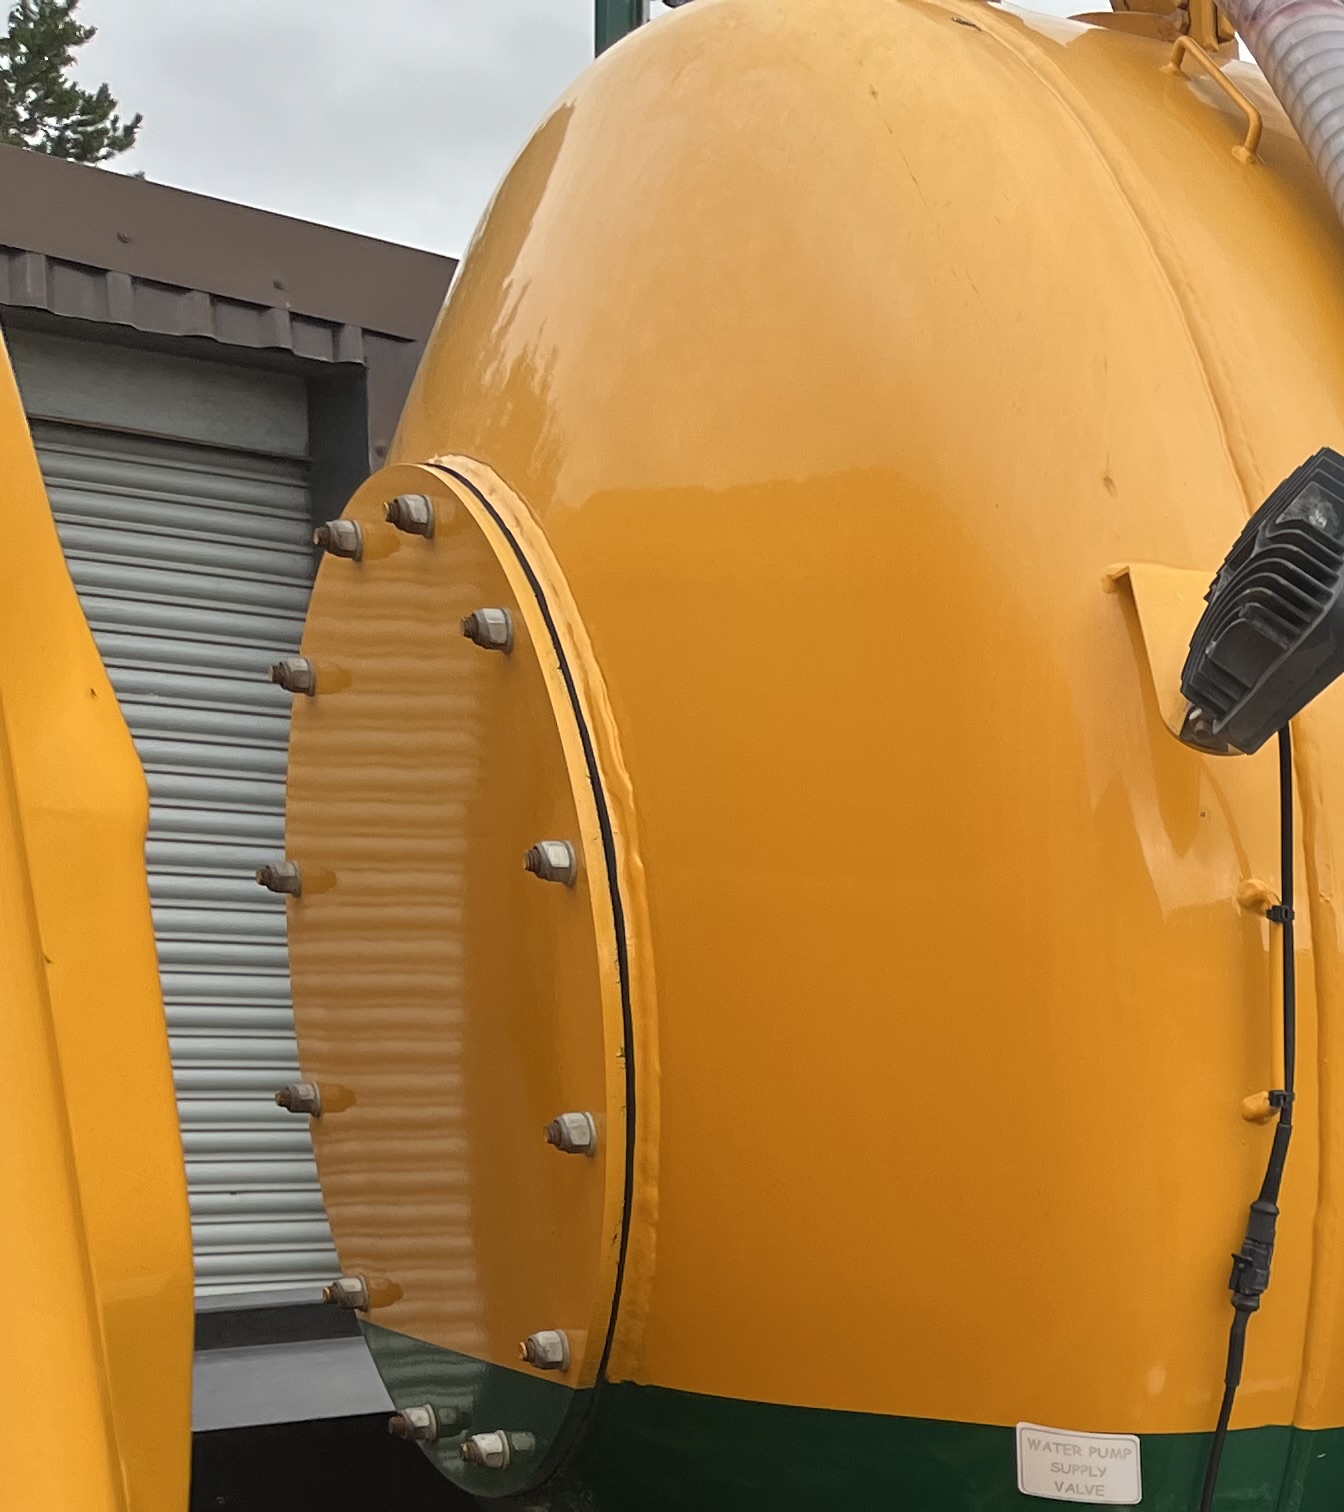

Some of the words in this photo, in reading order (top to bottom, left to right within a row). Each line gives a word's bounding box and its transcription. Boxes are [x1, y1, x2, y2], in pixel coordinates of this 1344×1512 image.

[1027, 1437, 1083, 1457] WATER
[1088, 1446, 1132, 1460] PUMP
[1050, 1462, 1106, 1478] SUPPLY
[1054, 1481, 1105, 1497] VALVE
